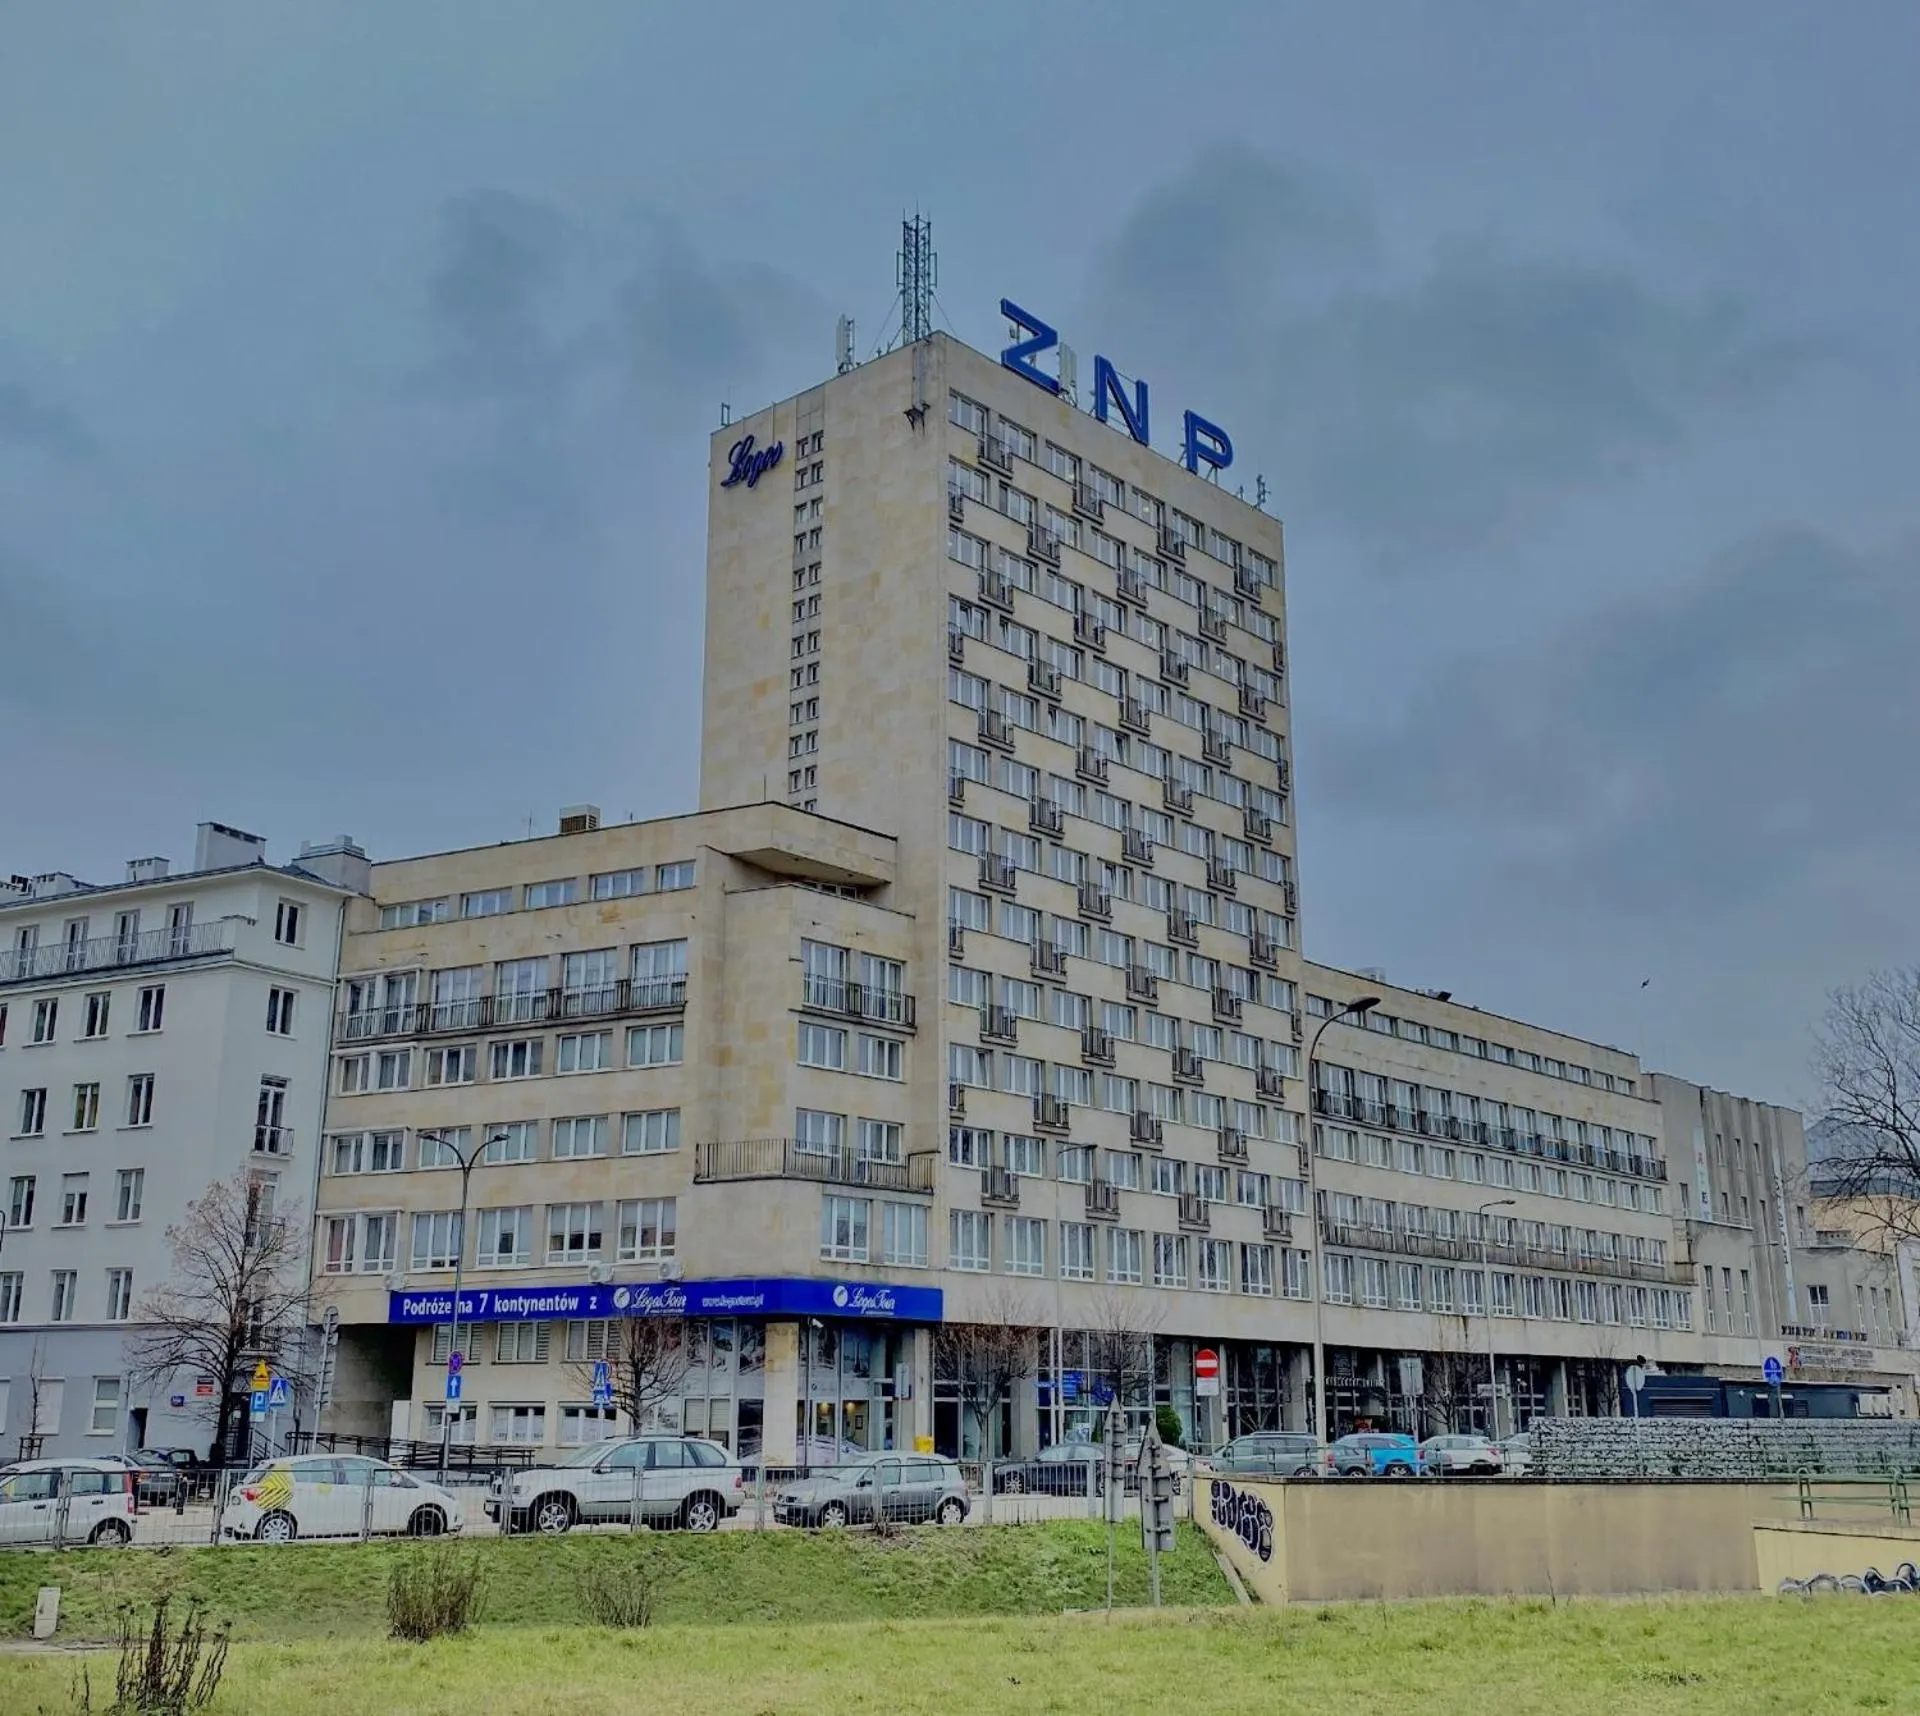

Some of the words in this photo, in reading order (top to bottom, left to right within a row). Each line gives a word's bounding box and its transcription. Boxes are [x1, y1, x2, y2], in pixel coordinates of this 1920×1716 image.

[1000, 298, 1234, 475] ZNP
[403, 1297, 452, 1316] Podróże
[457, 1300, 473, 1314] na
[479, 1293, 488, 1314] 7
[494, 1292, 579, 1316] kontynentów
[589, 1296, 598, 1309] z
